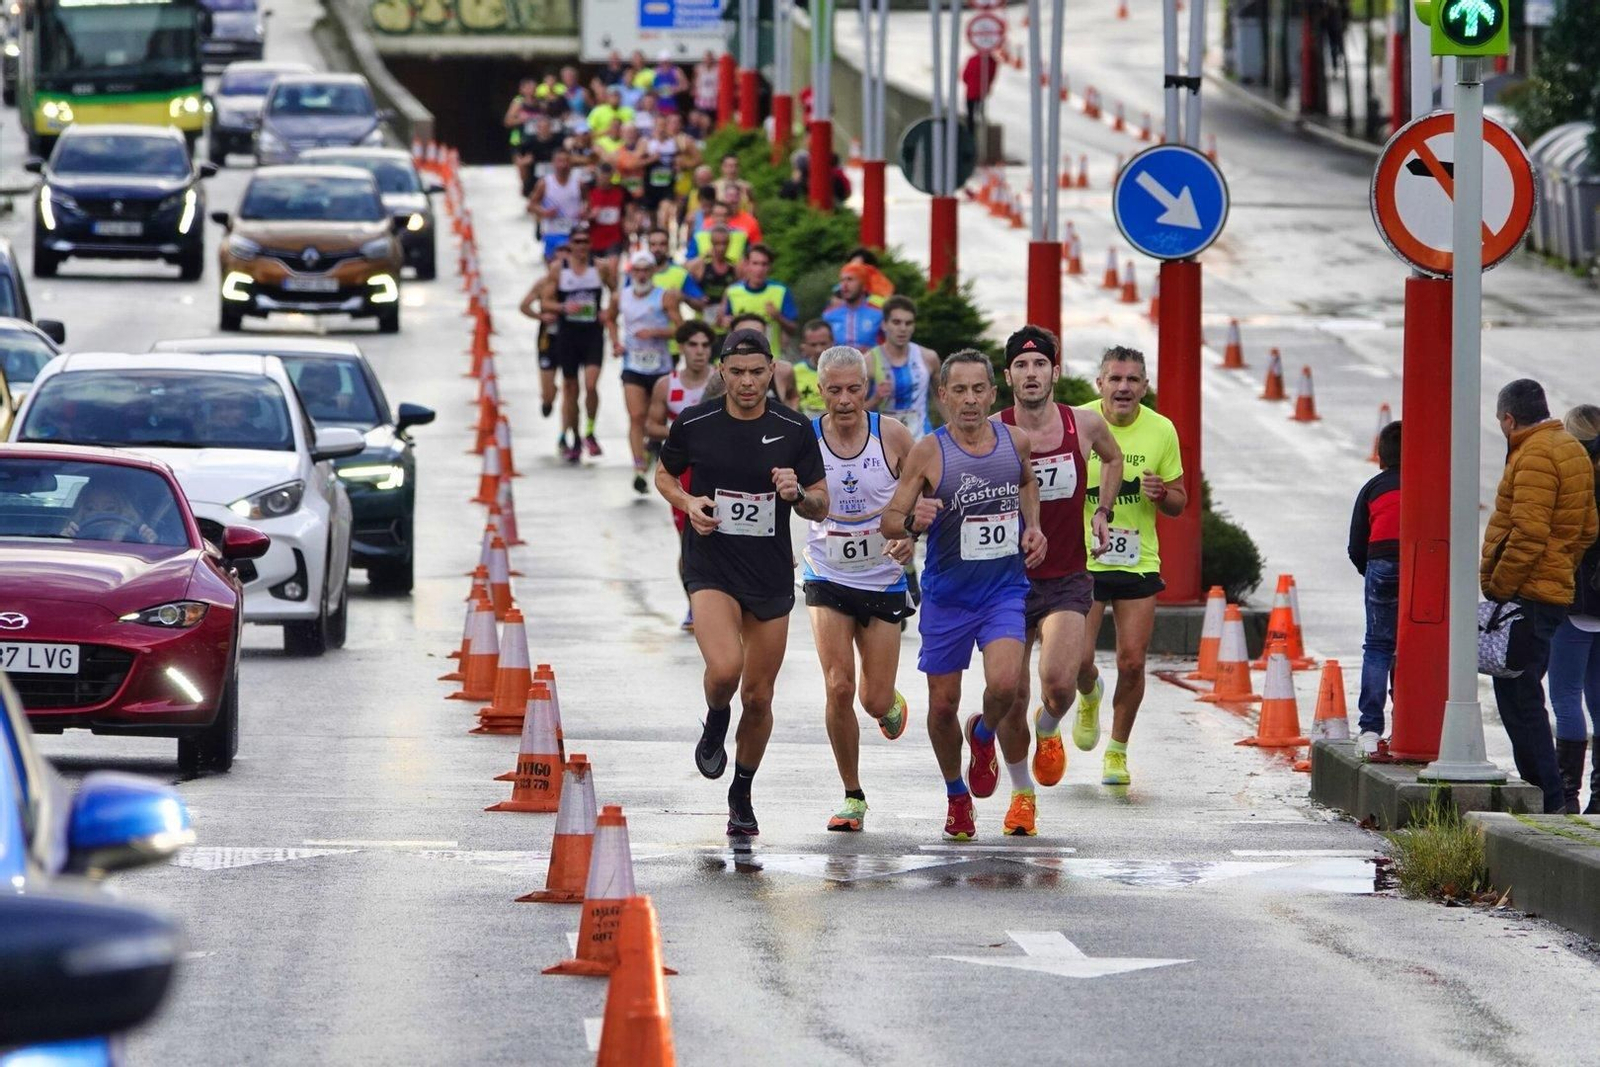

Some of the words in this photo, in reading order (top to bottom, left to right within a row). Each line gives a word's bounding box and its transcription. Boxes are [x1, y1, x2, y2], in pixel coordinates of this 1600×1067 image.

[731, 502, 760, 523] 92
[978, 525, 1006, 545] 30
[842, 538, 869, 559] 61
[28, 647, 72, 669] LVG
